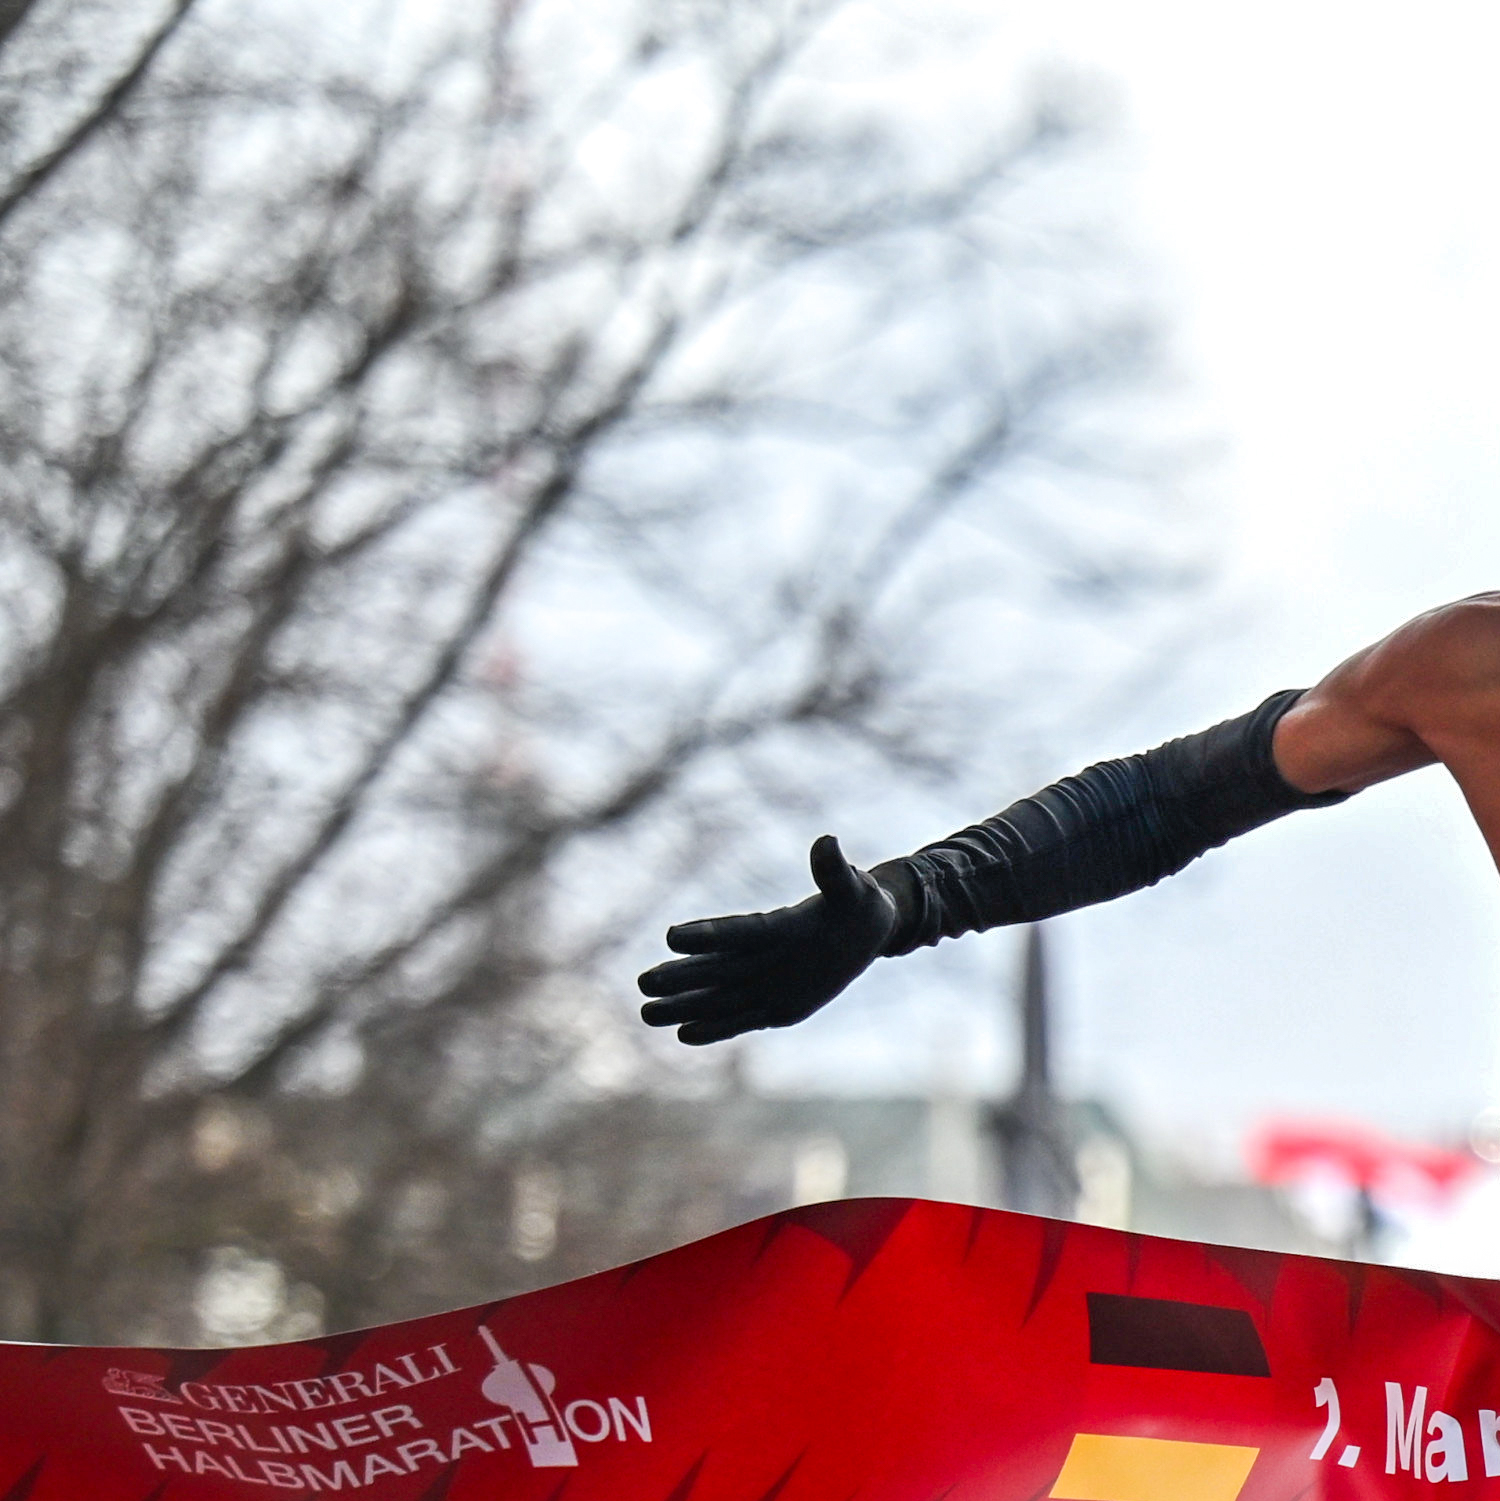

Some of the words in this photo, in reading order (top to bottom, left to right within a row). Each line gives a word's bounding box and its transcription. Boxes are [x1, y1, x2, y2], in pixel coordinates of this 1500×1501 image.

[178, 1342, 462, 1414] GENERALI
[118, 1403, 424, 1455] BERLINER
[142, 1395, 653, 1492] HALBMARATHON
